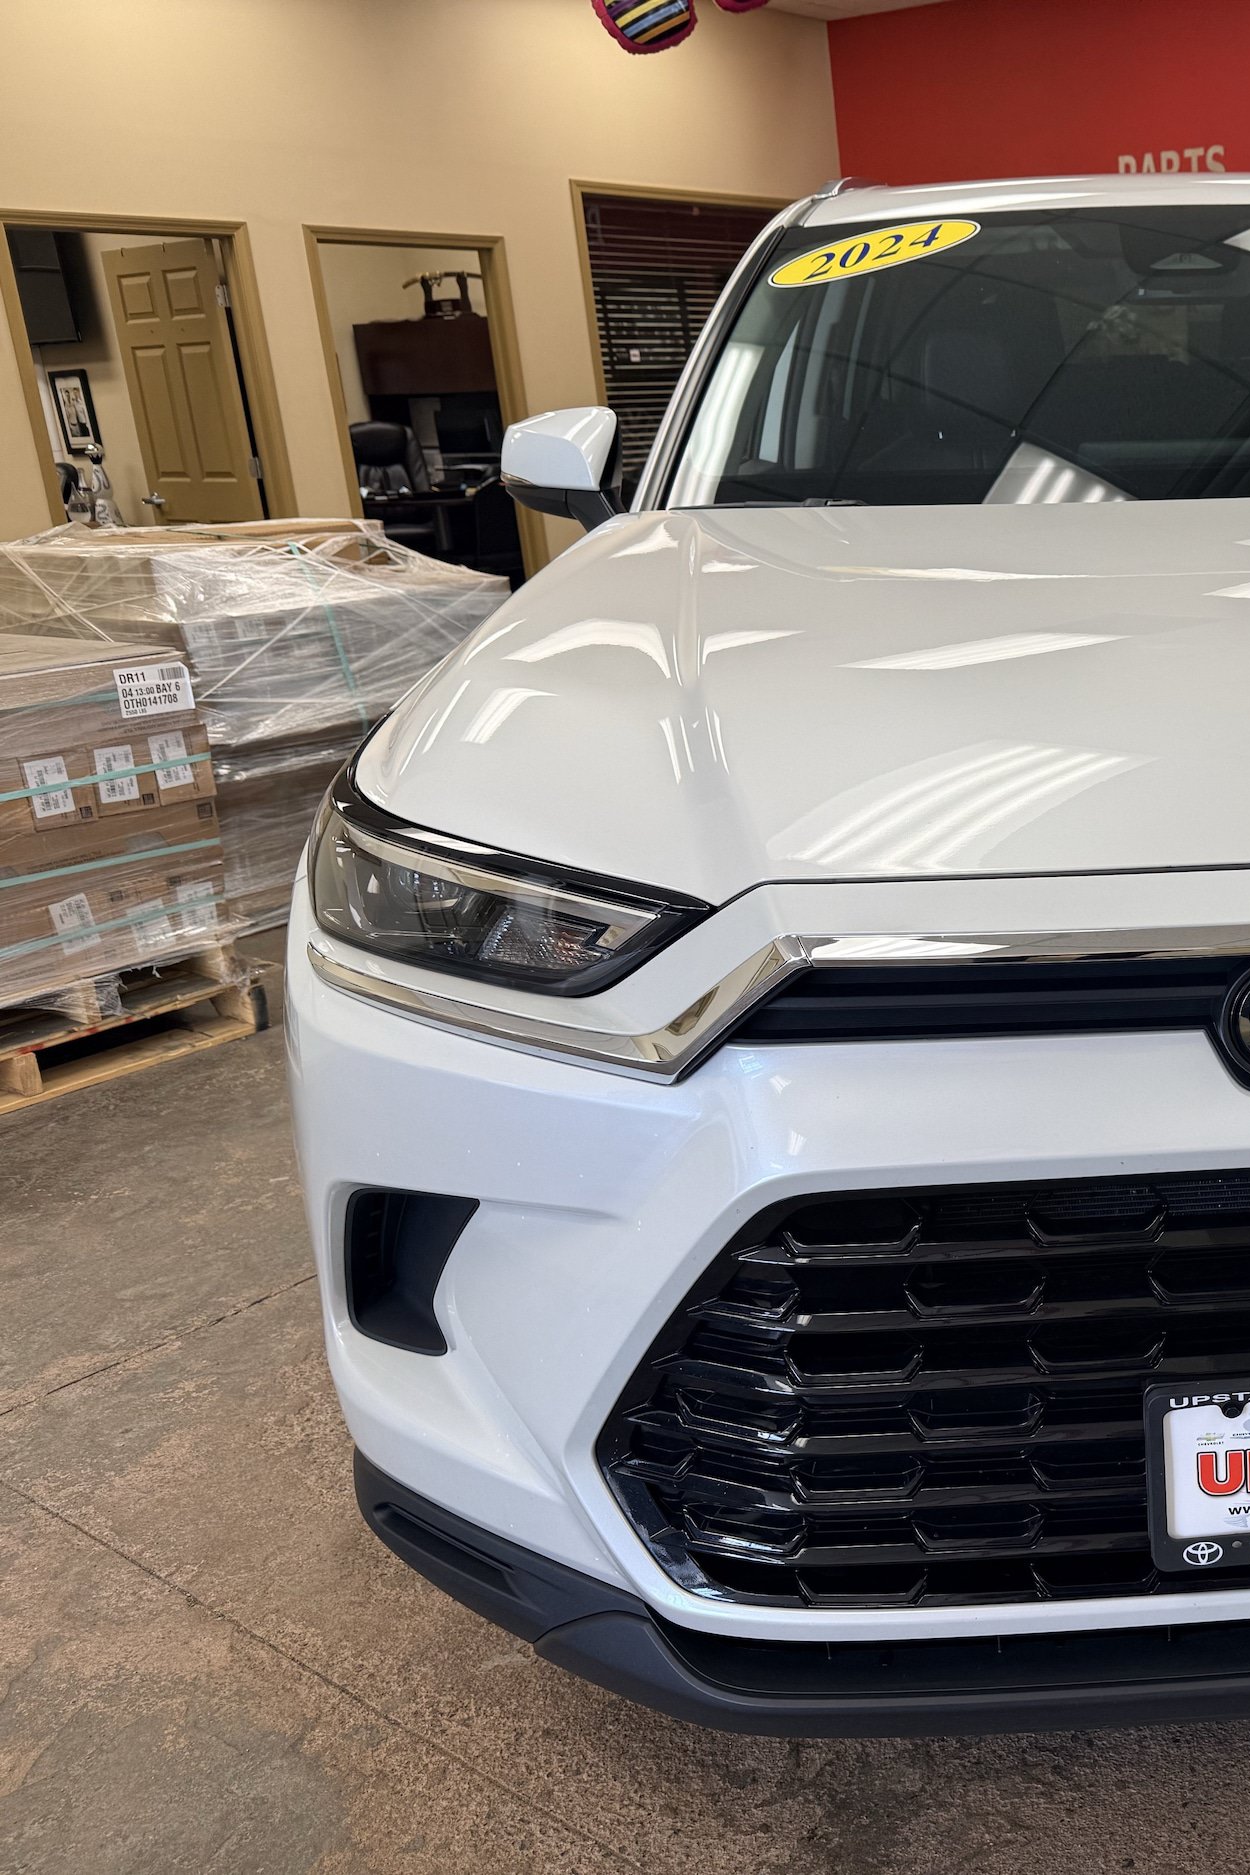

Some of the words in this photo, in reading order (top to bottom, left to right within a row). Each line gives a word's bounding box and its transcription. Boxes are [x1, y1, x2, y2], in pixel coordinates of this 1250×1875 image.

[802, 224, 943, 281] 2024
[119, 672, 146, 684] DR11
[122, 688, 133, 698] 04
[135, 687, 154, 696] 13:00
[156, 682, 172, 694] BAY
[175, 682, 180, 691] 6
